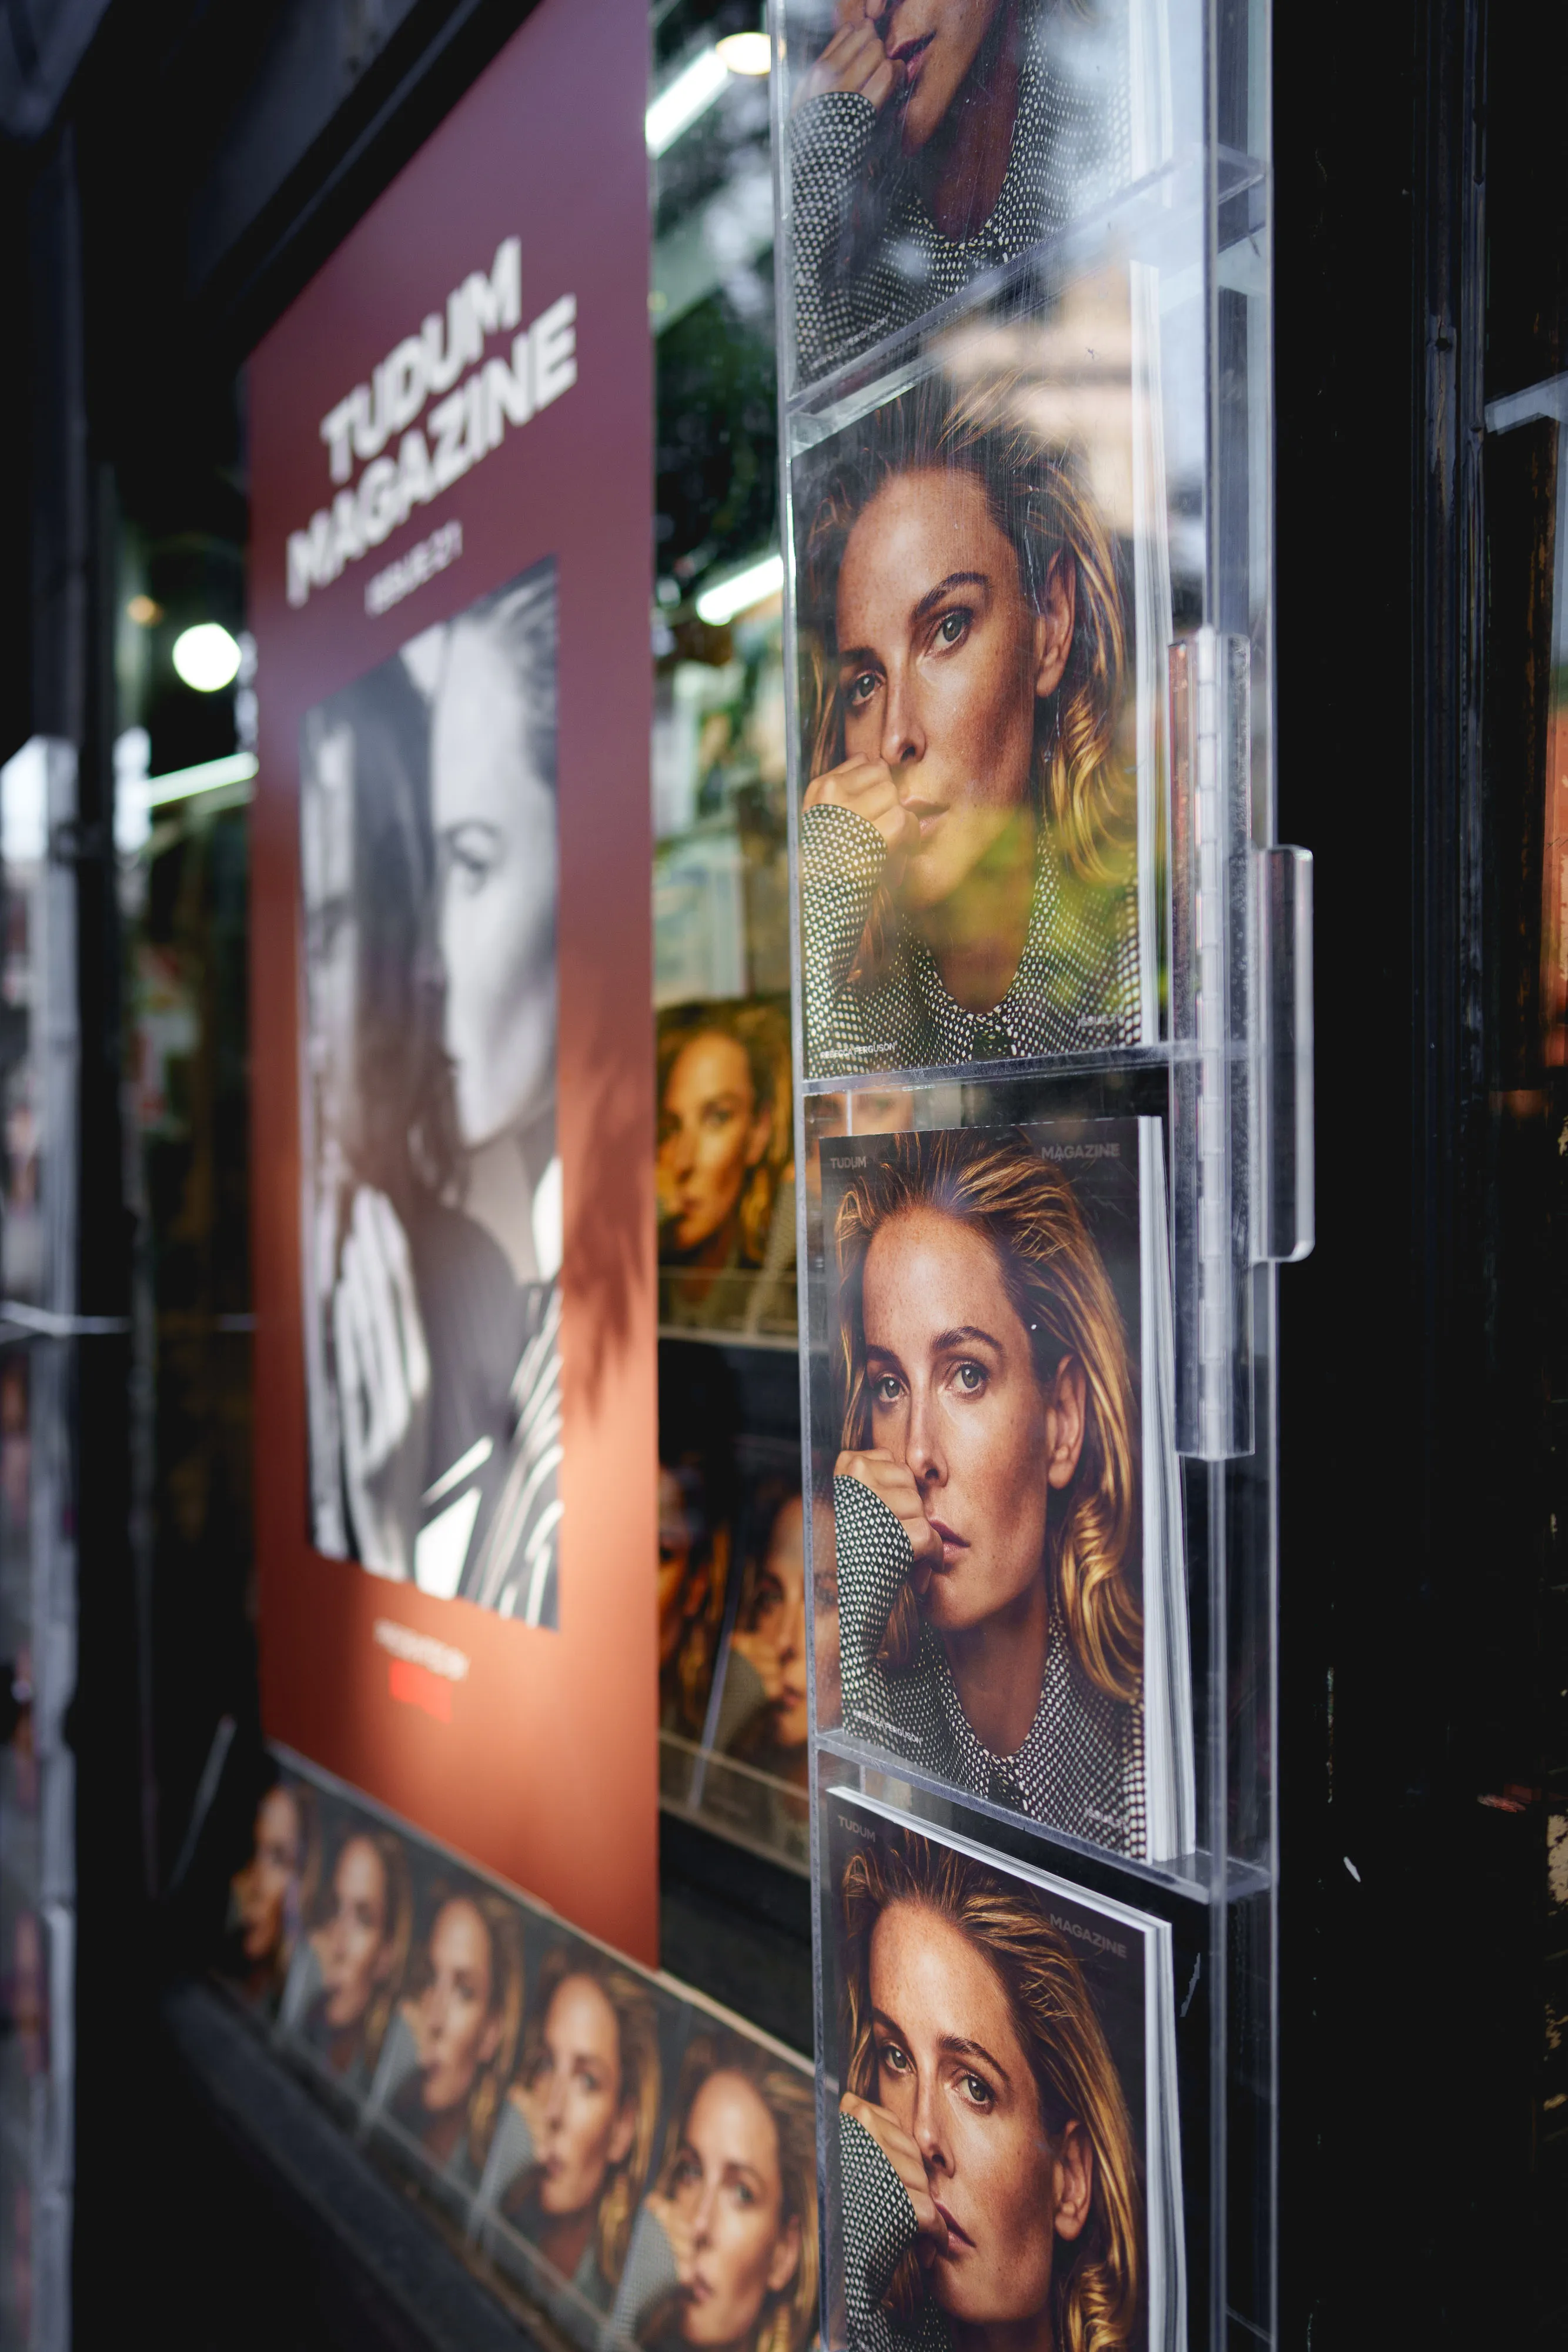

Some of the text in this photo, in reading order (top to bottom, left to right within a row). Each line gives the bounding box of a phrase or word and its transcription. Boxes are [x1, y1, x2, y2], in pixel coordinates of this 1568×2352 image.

[320, 235, 521, 483] TUDUM
[286, 293, 577, 608] MAGAZINE
[820, 1042, 896, 1059] REBECCA FERGUSON
[830, 1156, 867, 1169] TUDUM
[1042, 1142, 1121, 1160] MAGAZINE
[884, 1722, 923, 1748] FERGUSON
[837, 1815, 876, 1843] TUDUM
[1049, 1913, 1128, 1959] MAGAZINE
